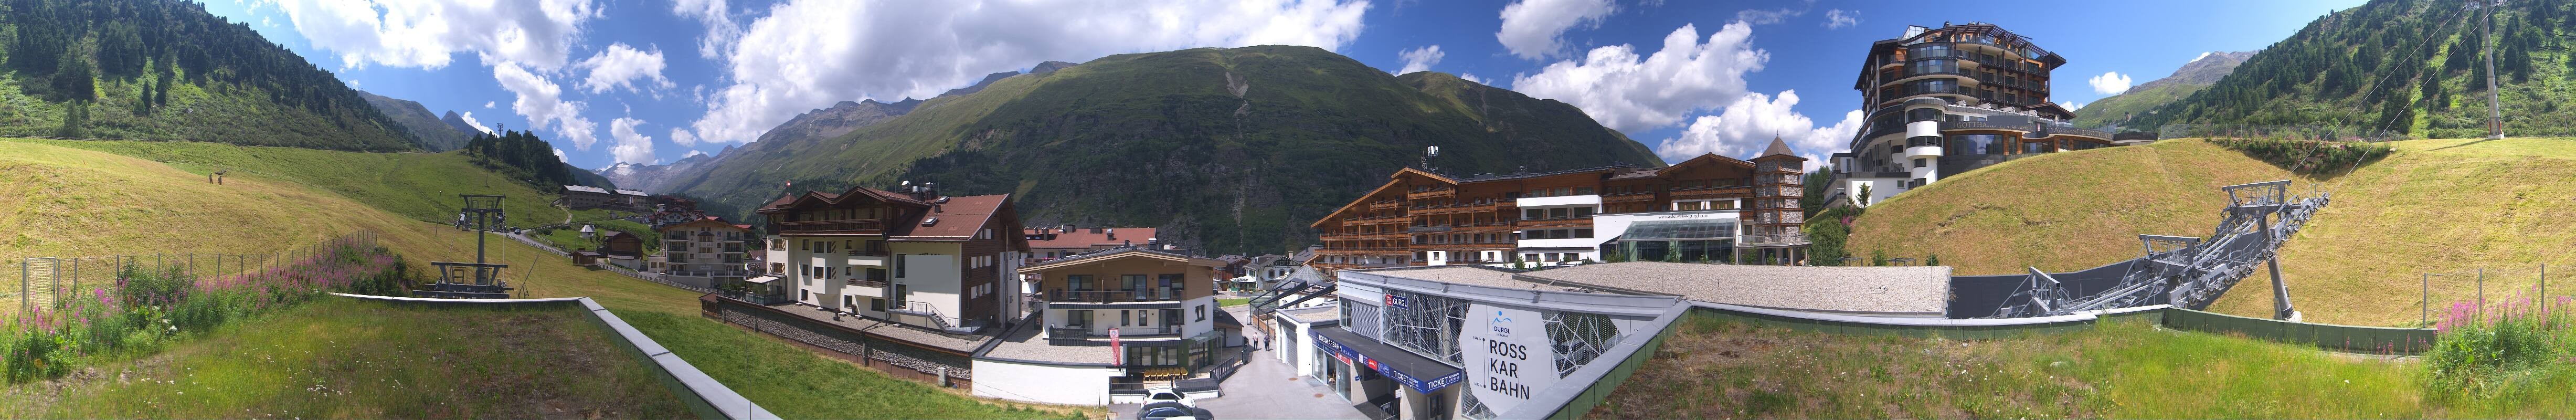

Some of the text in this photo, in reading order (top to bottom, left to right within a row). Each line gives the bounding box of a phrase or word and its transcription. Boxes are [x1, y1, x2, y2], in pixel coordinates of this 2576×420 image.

[2086, 130, 2114, 139] GOTTHARD
[1393, 298, 1407, 307] GURGL
[1319, 334, 1342, 352] ROSSKARBAHN
[1490, 339, 1526, 361] ROSS
[1490, 358, 1518, 378] KAR
[1393, 370, 1409, 383] TICKET
[1427, 376, 1449, 389] TICKET
[1491, 376, 1530, 400] BAHN
